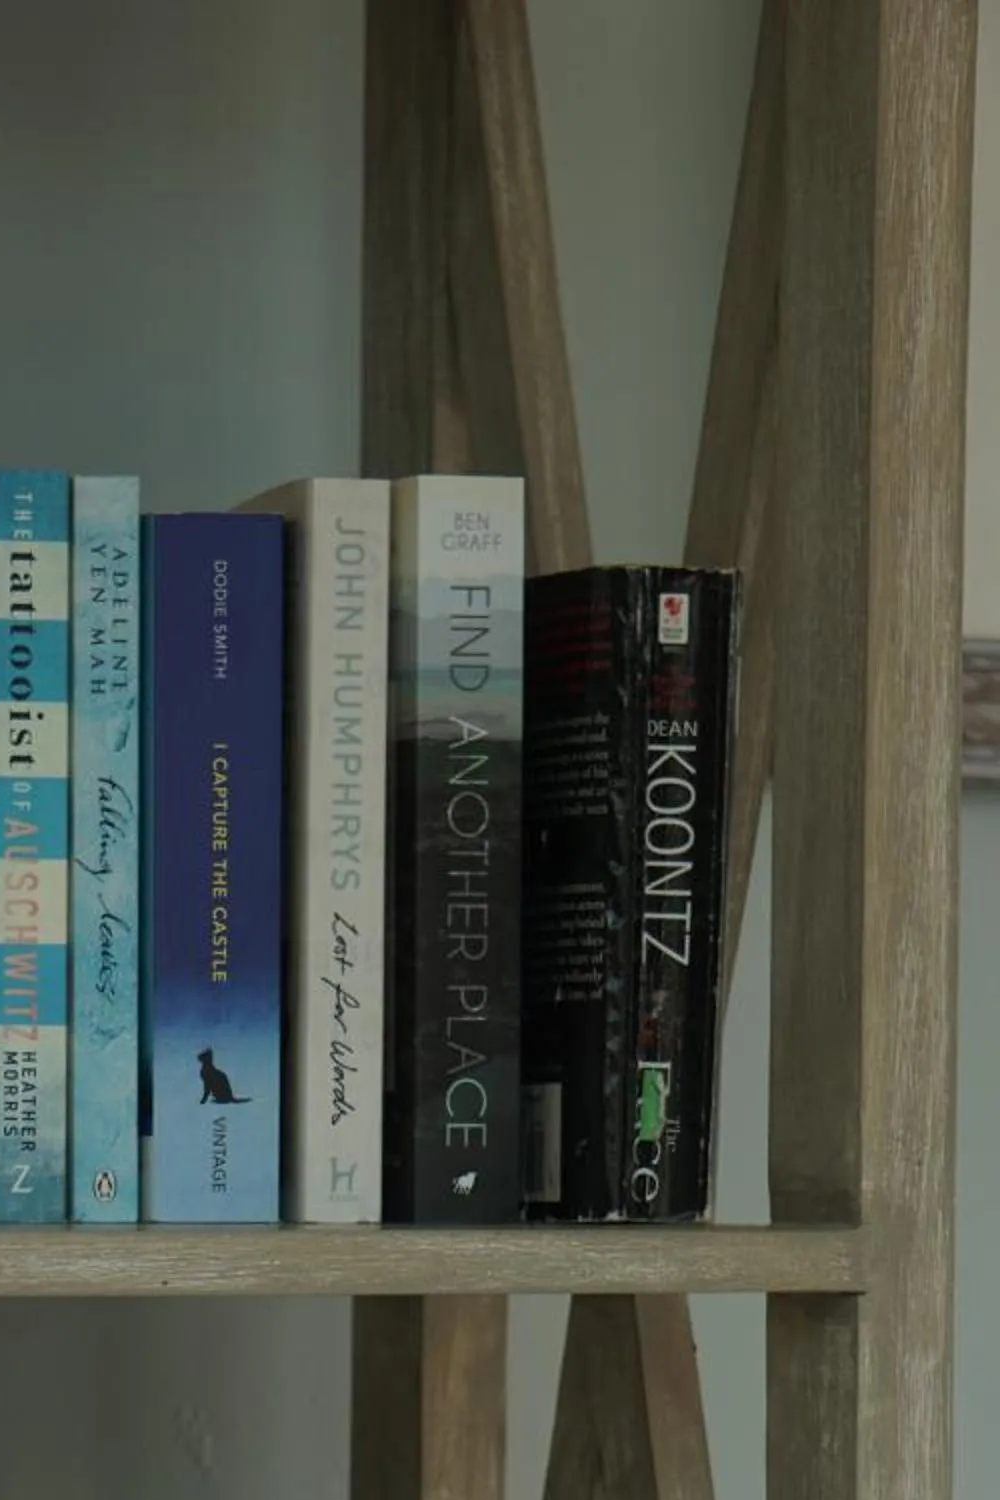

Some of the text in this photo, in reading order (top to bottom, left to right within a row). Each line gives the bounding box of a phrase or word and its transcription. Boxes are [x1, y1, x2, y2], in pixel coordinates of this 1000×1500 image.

[441, 532, 502, 552] GRAFF
[454, 512, 490, 531] BEN
[90, 543, 107, 696] YEN MAH
[111, 548, 128, 692] ADELINE
[213, 560, 229, 679] DODIE SMITH
[3, 493, 44, 1042] THE tattooist OF AUSCHWITZ
[331, 517, 364, 892] JOHN HUMPHRYS
[647, 719, 699, 737] DEAN
[211, 757, 230, 983] CAPTURE THE CASTLE
[444, 585, 491, 1148] FIND ANOTHER PLACE
[641, 744, 698, 966] KOONTZ
[321, 911, 360, 1126] Lost for Words
[3, 1051, 18, 1137] MORRIS
[20, 1051, 37, 1152] HEATHER
[211, 1116, 227, 1193] VINTAGE
